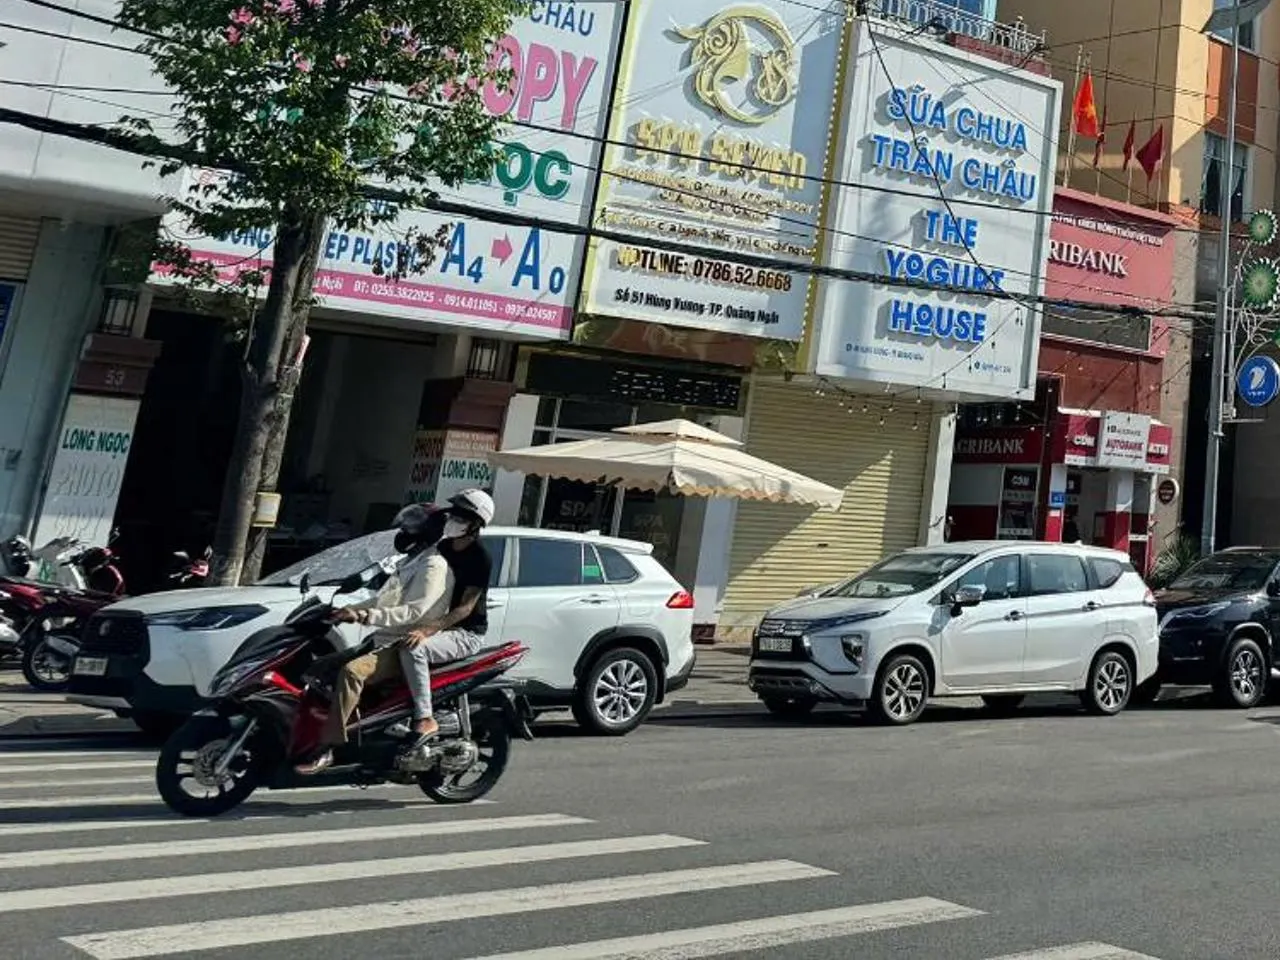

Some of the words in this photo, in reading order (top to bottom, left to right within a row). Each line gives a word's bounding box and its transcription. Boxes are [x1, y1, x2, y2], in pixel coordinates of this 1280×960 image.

[482, 33, 598, 132] OPY
[888, 83, 948, 130] SỮA
[956, 107, 1029, 152] CHUA
[873, 135, 953, 181] TRÂN
[963, 159, 1037, 202] CHÂU
[926, 209, 979, 249] THE
[617, 246, 689, 275] HOTLINE:
[887, 249, 1006, 293] YOGURT
[1048, 239, 1128, 277] RIBANK
[890, 299, 987, 342] HOUSE
[62, 427, 96, 451] LONG
[97, 431, 131, 459] NGỌC
